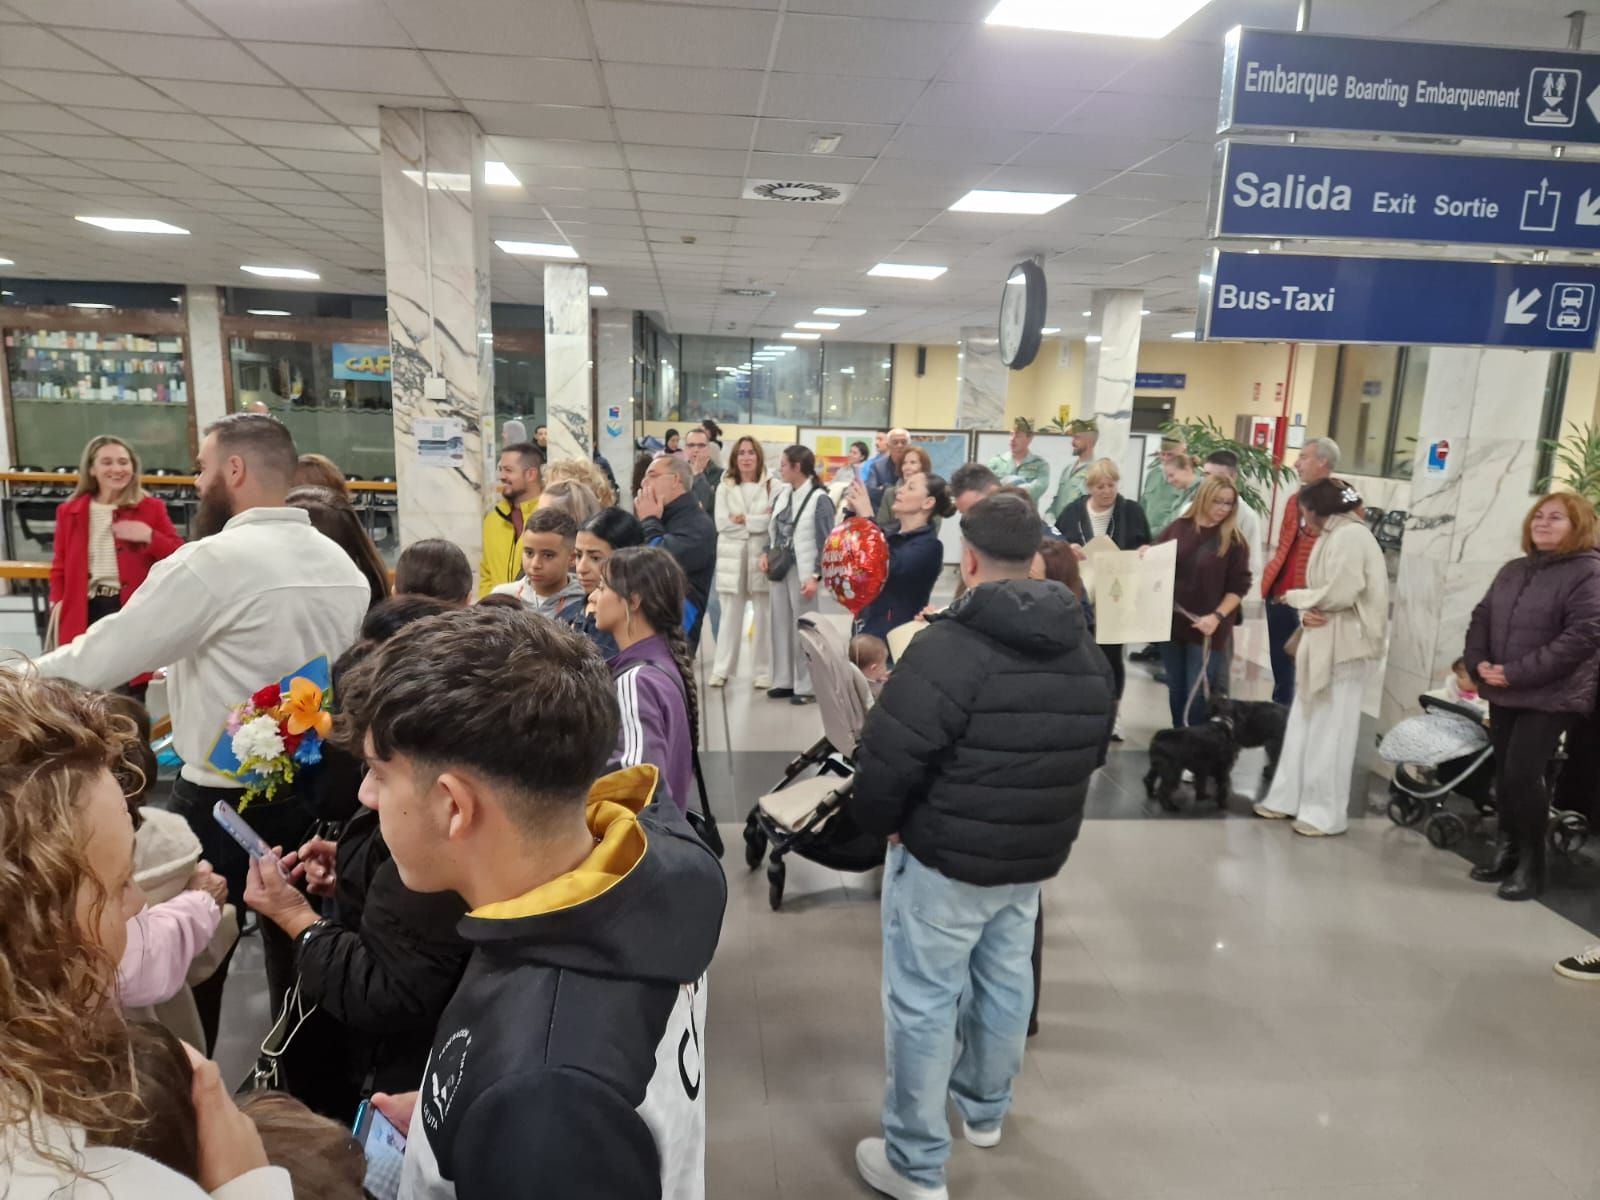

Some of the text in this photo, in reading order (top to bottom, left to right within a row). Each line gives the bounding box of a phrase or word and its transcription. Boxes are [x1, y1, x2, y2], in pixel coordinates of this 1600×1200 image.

[1245, 61, 1520, 111] Embarque Boarding Embarquement
[1233, 172, 1498, 218] Salida Exit Sortie
[1218, 285, 1335, 311] Bus-Taxi
